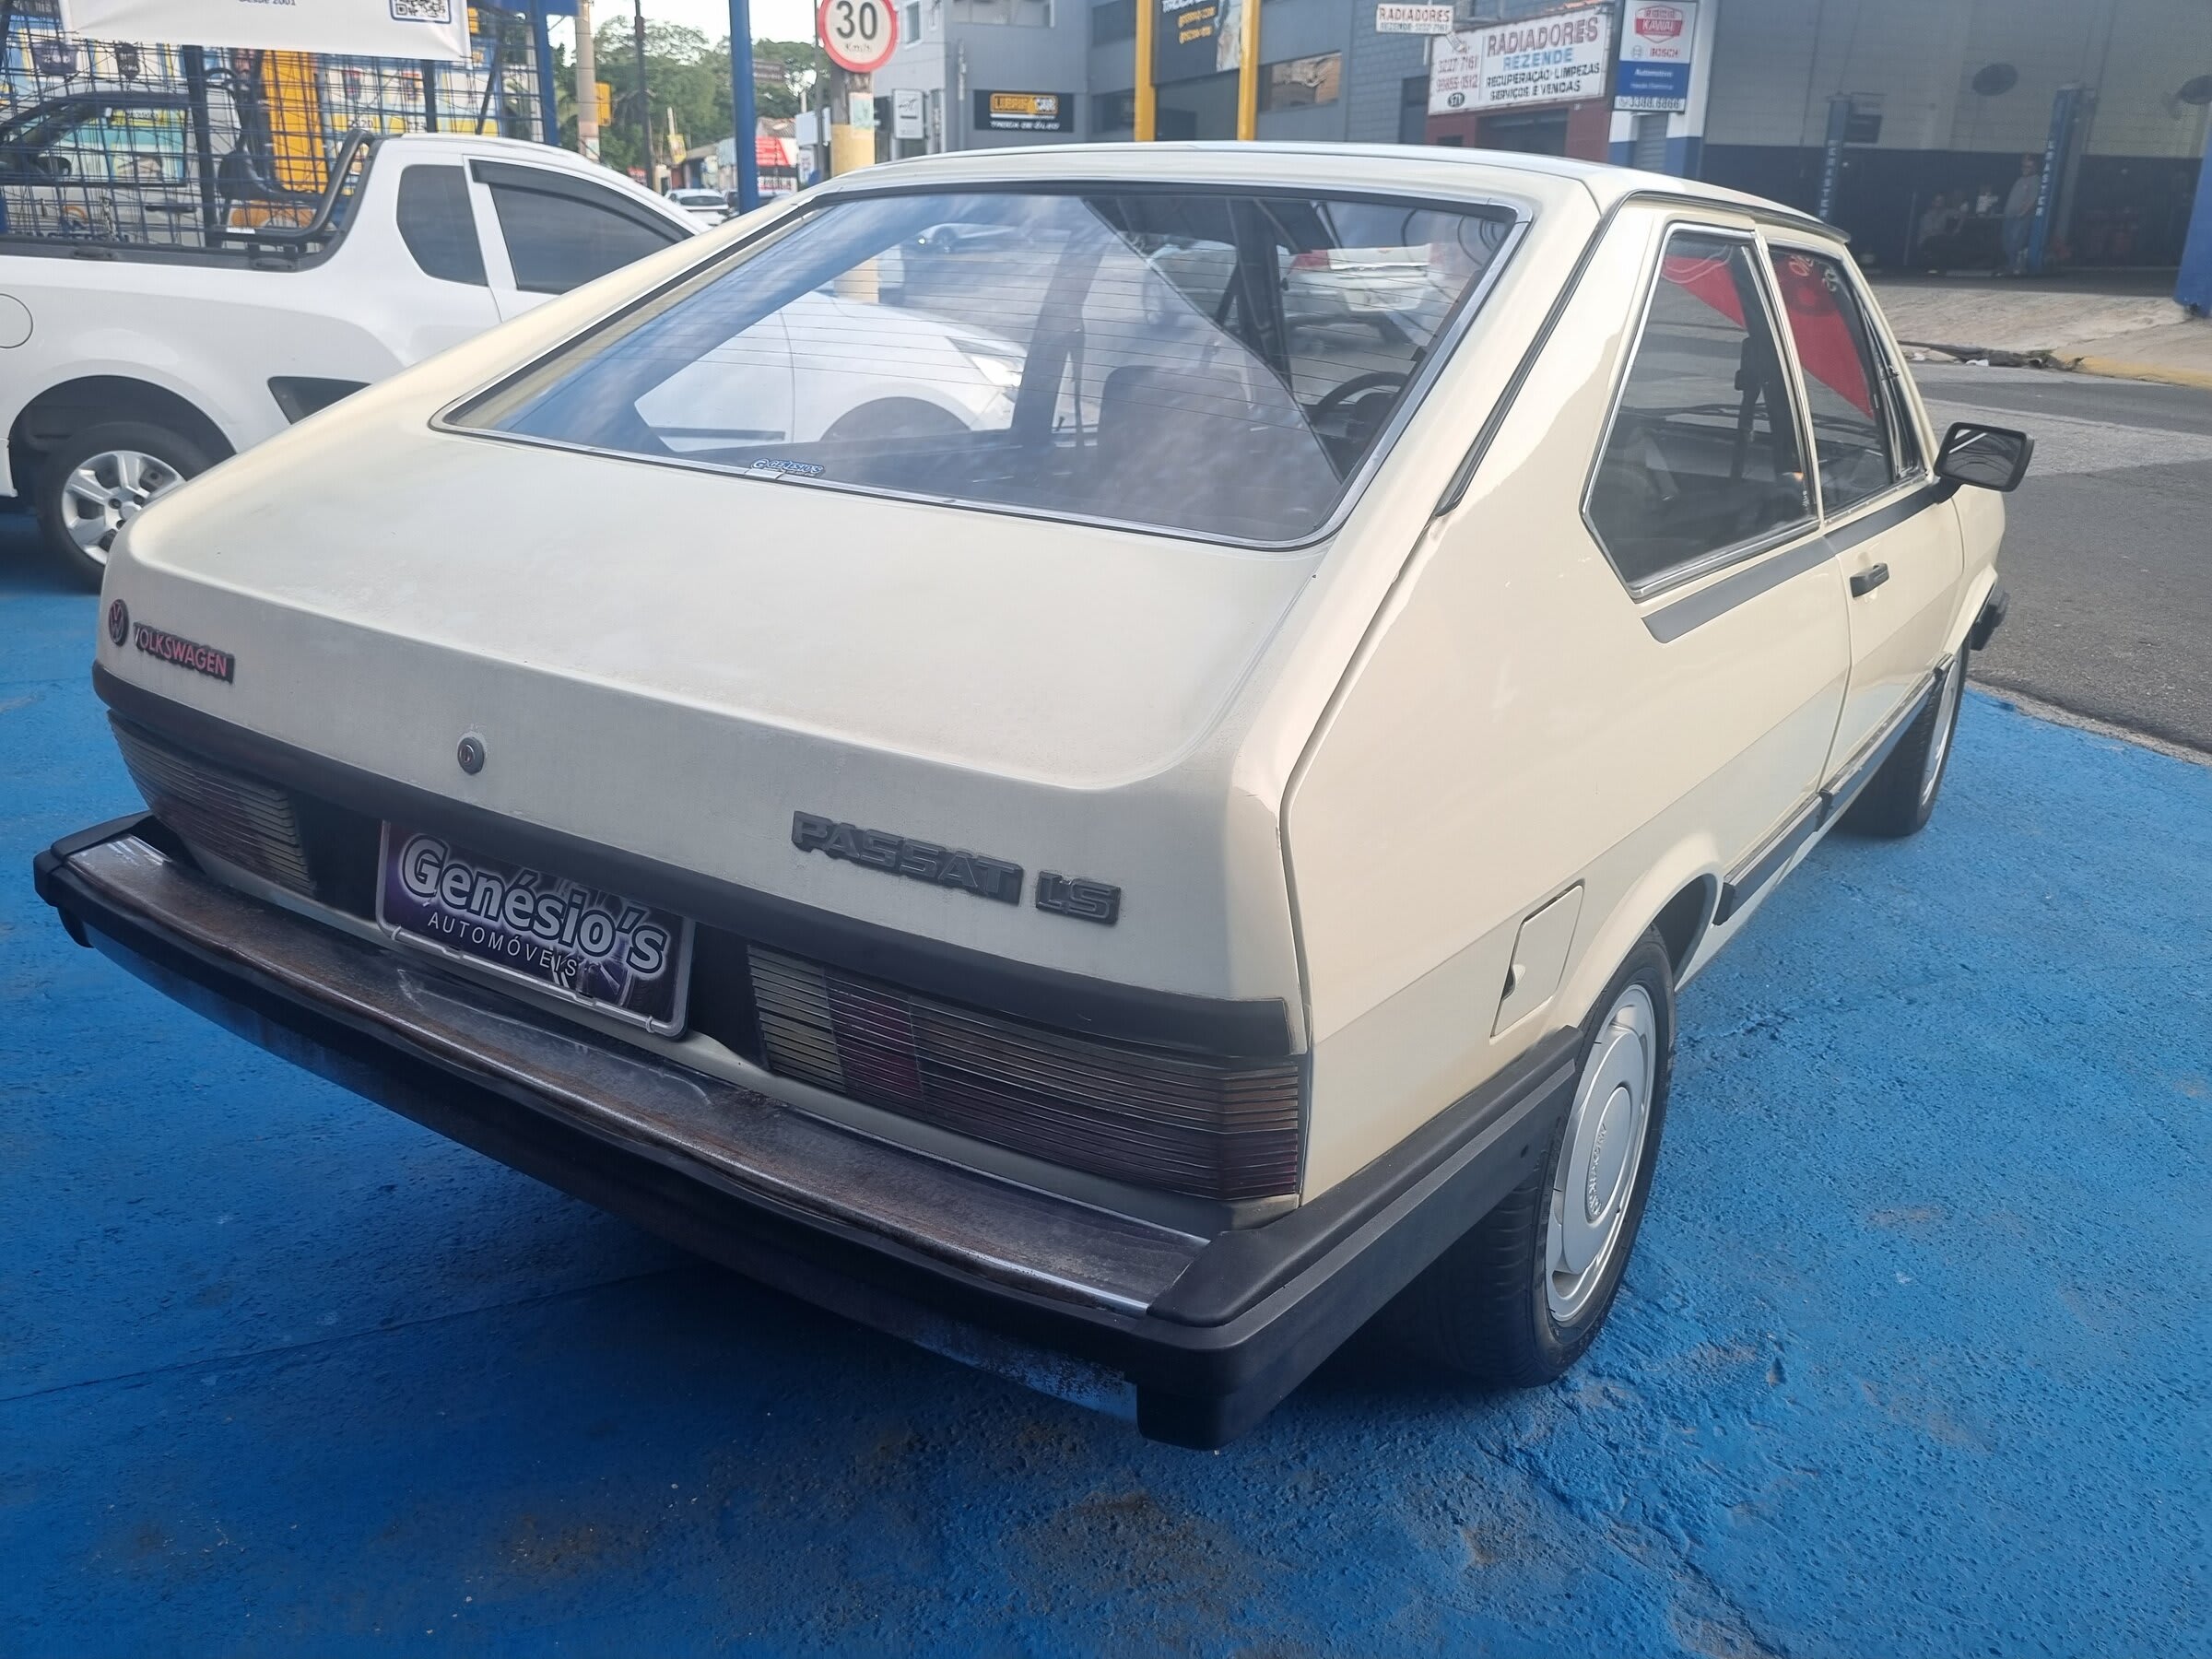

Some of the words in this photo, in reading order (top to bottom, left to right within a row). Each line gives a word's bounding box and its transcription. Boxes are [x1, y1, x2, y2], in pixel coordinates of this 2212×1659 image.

[836, 1, 878, 41] 30
[1379, 7, 1450, 22] RADIADORES
[1641, 19, 1674, 31] KAWAI
[1488, 17, 1598, 57] RADIADORES
[1503, 47, 1573, 71] REZENDE
[1555, 63, 1600, 78] LIMPEZAS
[1541, 80, 1581, 95] VENDAS
[134, 624, 232, 681] VOLKSWAGEN
[792, 811, 1023, 905] PASSAT
[1035, 871, 1121, 926] LS
[402, 834, 669, 973] Genésio's
[428, 912, 579, 978] AUTOMÓVEIS
